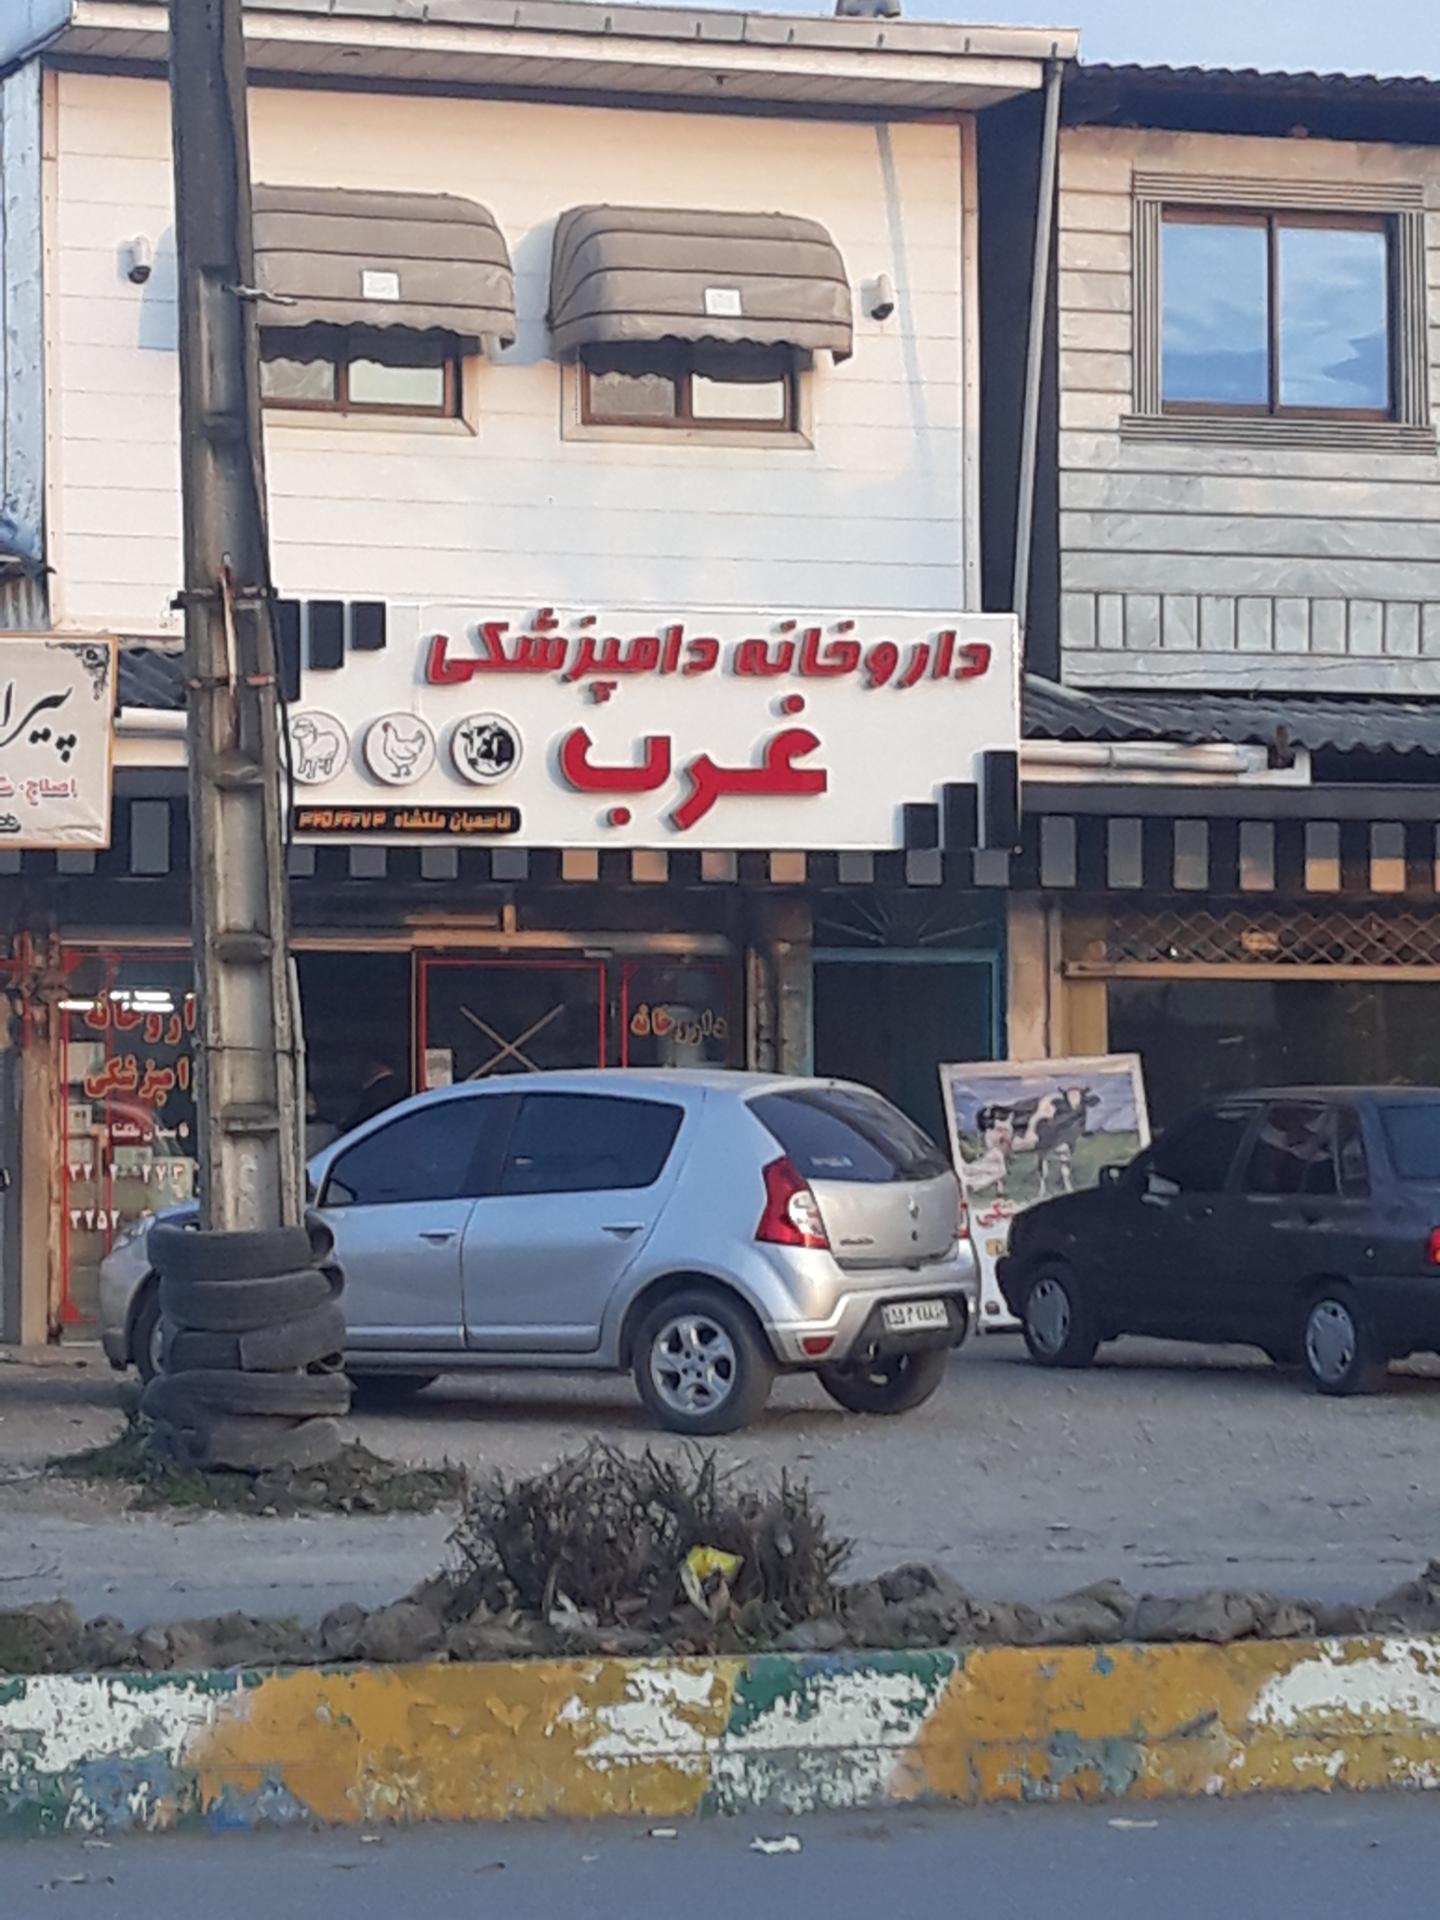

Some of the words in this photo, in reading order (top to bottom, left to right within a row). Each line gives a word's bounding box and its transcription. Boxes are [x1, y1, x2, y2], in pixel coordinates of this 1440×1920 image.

[425, 608, 720, 702] دامپزشکی
[733, 619, 993, 688] داروخانه
[559, 694, 828, 831] غرب
[84, 990, 197, 1045] اروخانه
[84, 1054, 190, 1107] امپزشکی
